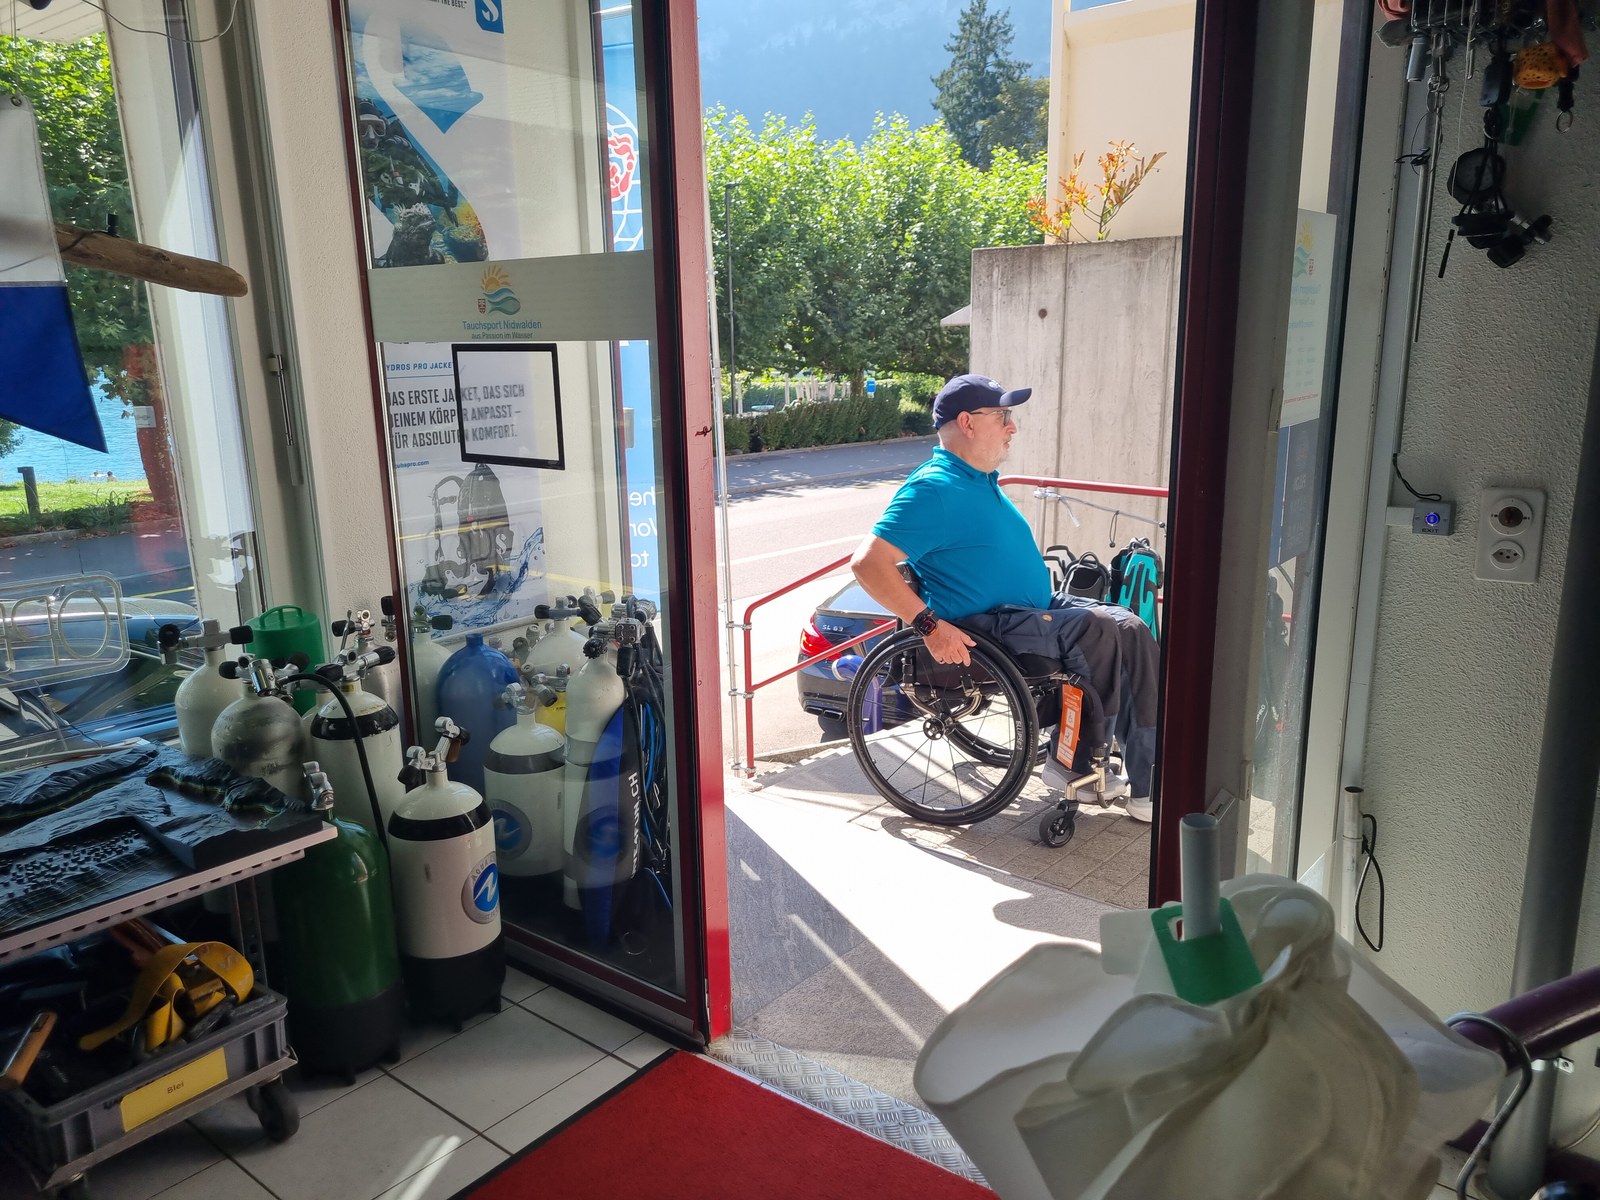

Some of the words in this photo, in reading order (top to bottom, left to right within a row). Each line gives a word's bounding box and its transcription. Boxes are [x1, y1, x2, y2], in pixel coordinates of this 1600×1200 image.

[462, 320, 502, 331] Tauchsport
[503, 319, 542, 329] Nidwalden
[512, 331, 533, 339] Wasser
[386, 362, 410, 371] YDROS
[413, 362, 427, 370] PRO
[430, 361, 453, 370] JACKE
[408, 389, 440, 405] ERSTE
[442, 386, 481, 403] JAKET,
[483, 385, 501, 399] DAS
[503, 384, 525, 398] SICH
[429, 407, 469, 425] KÖRPR
[471, 404, 512, 421] ANPASST
[392, 432, 409, 449] ÜR
[471, 424, 518, 441] KOMFORT.
[167, 1080, 184, 1094] Blei
